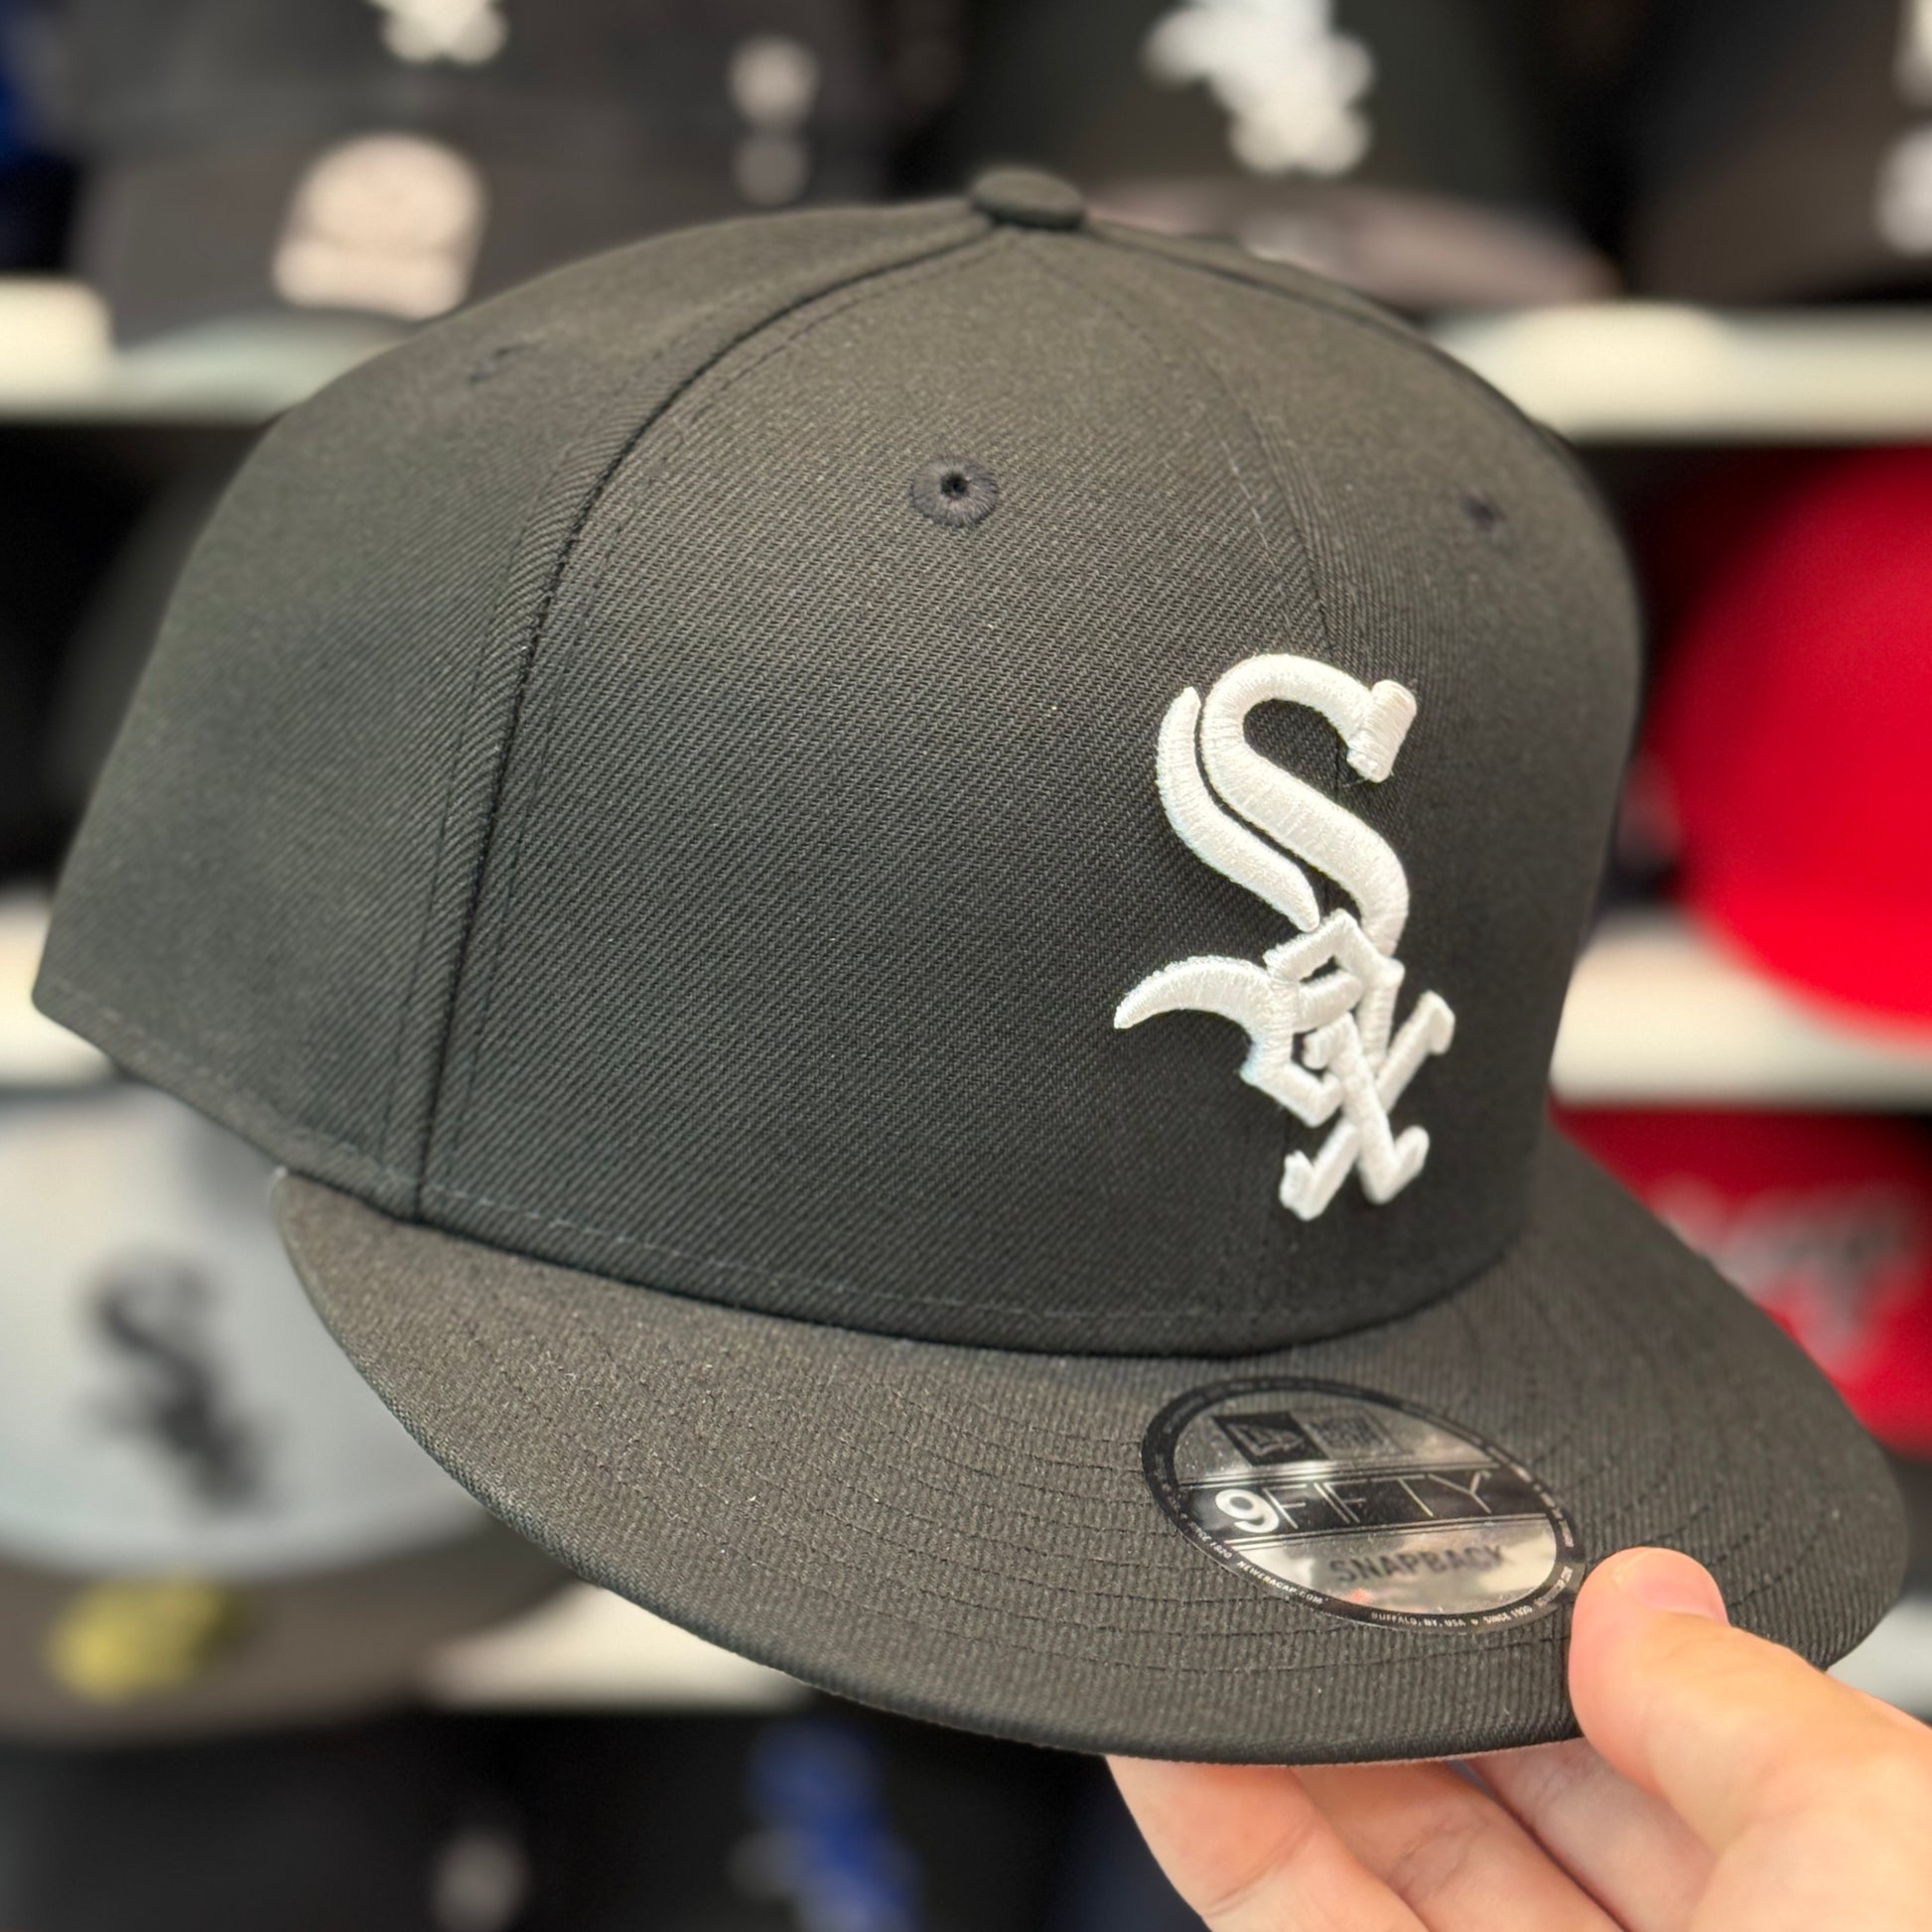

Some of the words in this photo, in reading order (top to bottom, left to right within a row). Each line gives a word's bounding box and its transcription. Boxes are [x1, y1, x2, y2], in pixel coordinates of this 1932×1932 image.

[1214, 1468, 1493, 1534] 9FIFTY
[1329, 1545, 1506, 1584] SNAPBACK
[1444, 1617, 1467, 1628] USA
